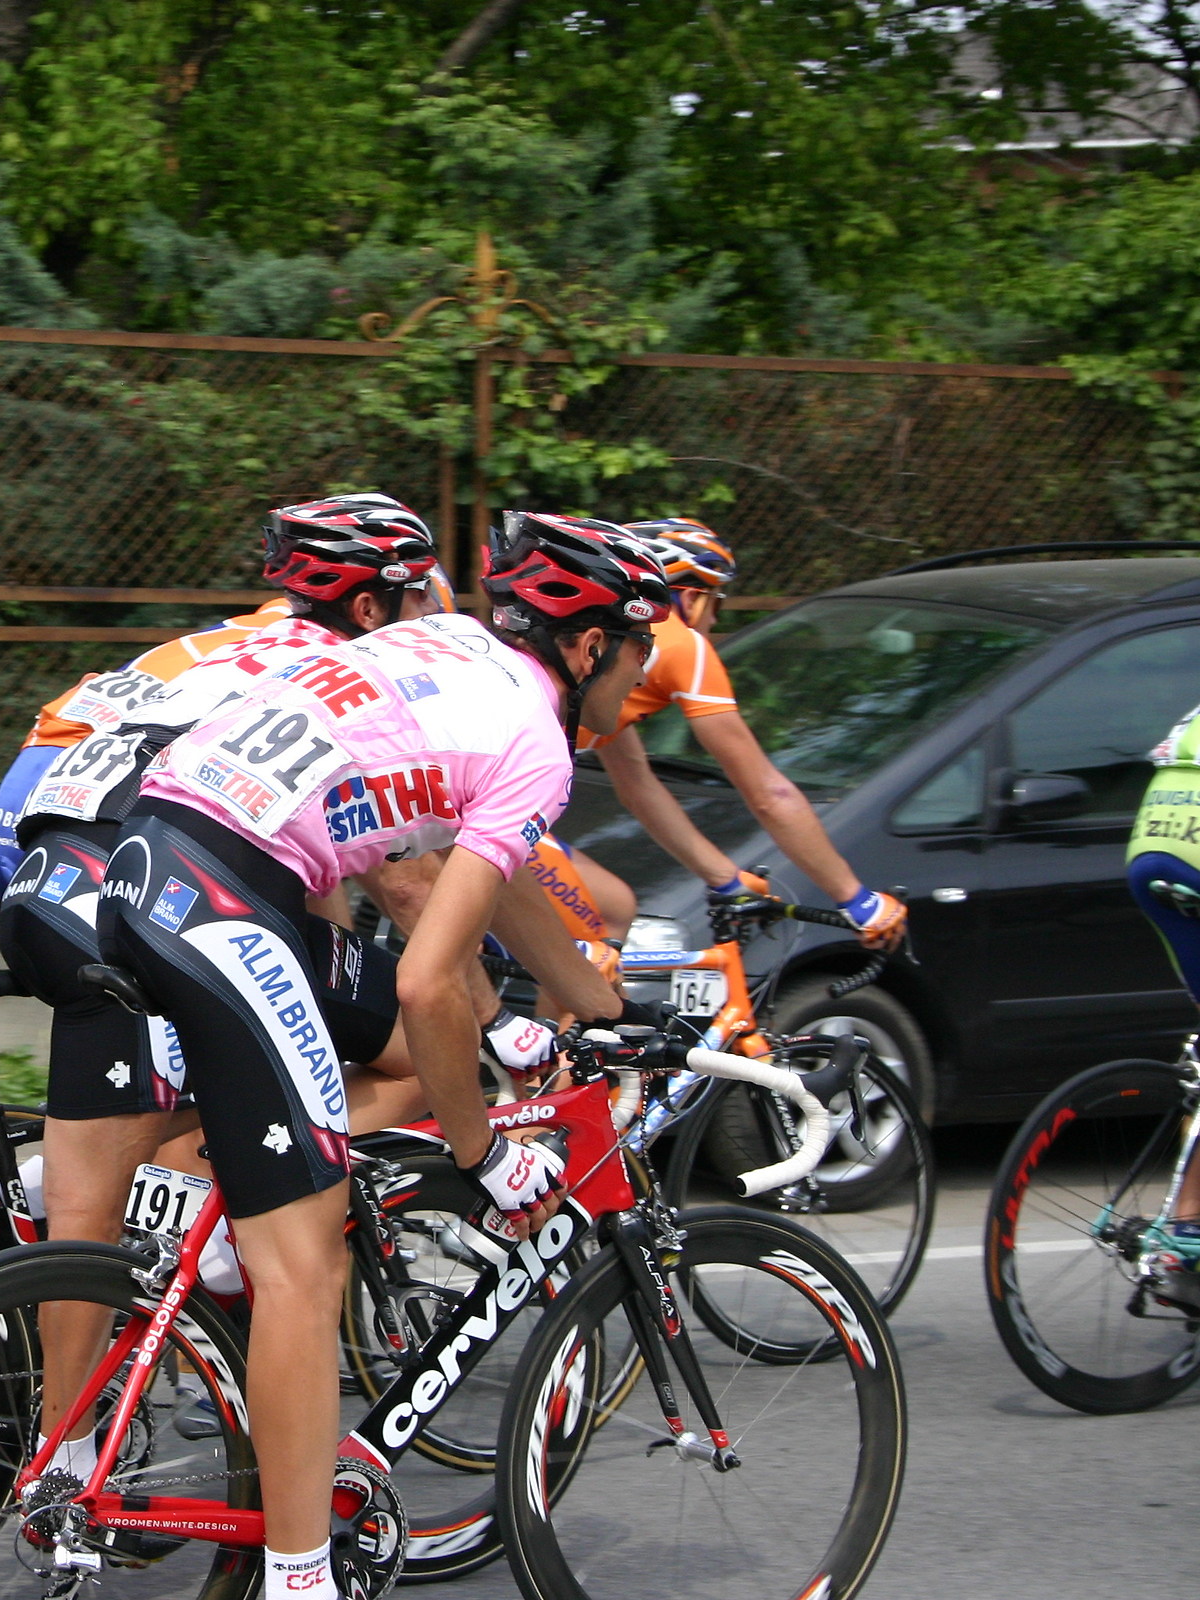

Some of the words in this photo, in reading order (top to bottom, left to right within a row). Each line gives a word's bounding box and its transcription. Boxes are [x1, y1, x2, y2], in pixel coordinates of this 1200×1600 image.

[384, 568, 408, 579] BELL
[629, 603, 651, 617] BELL
[289, 656, 381, 719] THE
[49, 738, 137, 782] 197
[220, 708, 334, 793] 191
[53, 784, 92, 809] THE
[198, 763, 226, 789] ESTA
[223, 772, 275, 818] THE
[363, 766, 459, 829] THE
[5, 878, 38, 900] MAN
[100, 879, 141, 906] MAN
[524, 849, 604, 934] Rabobank
[153, 905, 181, 925] BRAND
[674, 981, 711, 1014] 164
[514, 1022, 544, 1053] CSC
[488, 1104, 556, 1130] rvélo
[506, 1148, 536, 1192] CSC
[6, 1178, 28, 1211] CSC
[125, 1179, 189, 1237] 191
[354, 1176, 389, 1239] ALPHA
[638, 1245, 675, 1317] ALPHA
[137, 1277, 186, 1367] SOLOIST
[286, 1566, 327, 1591] CSC
